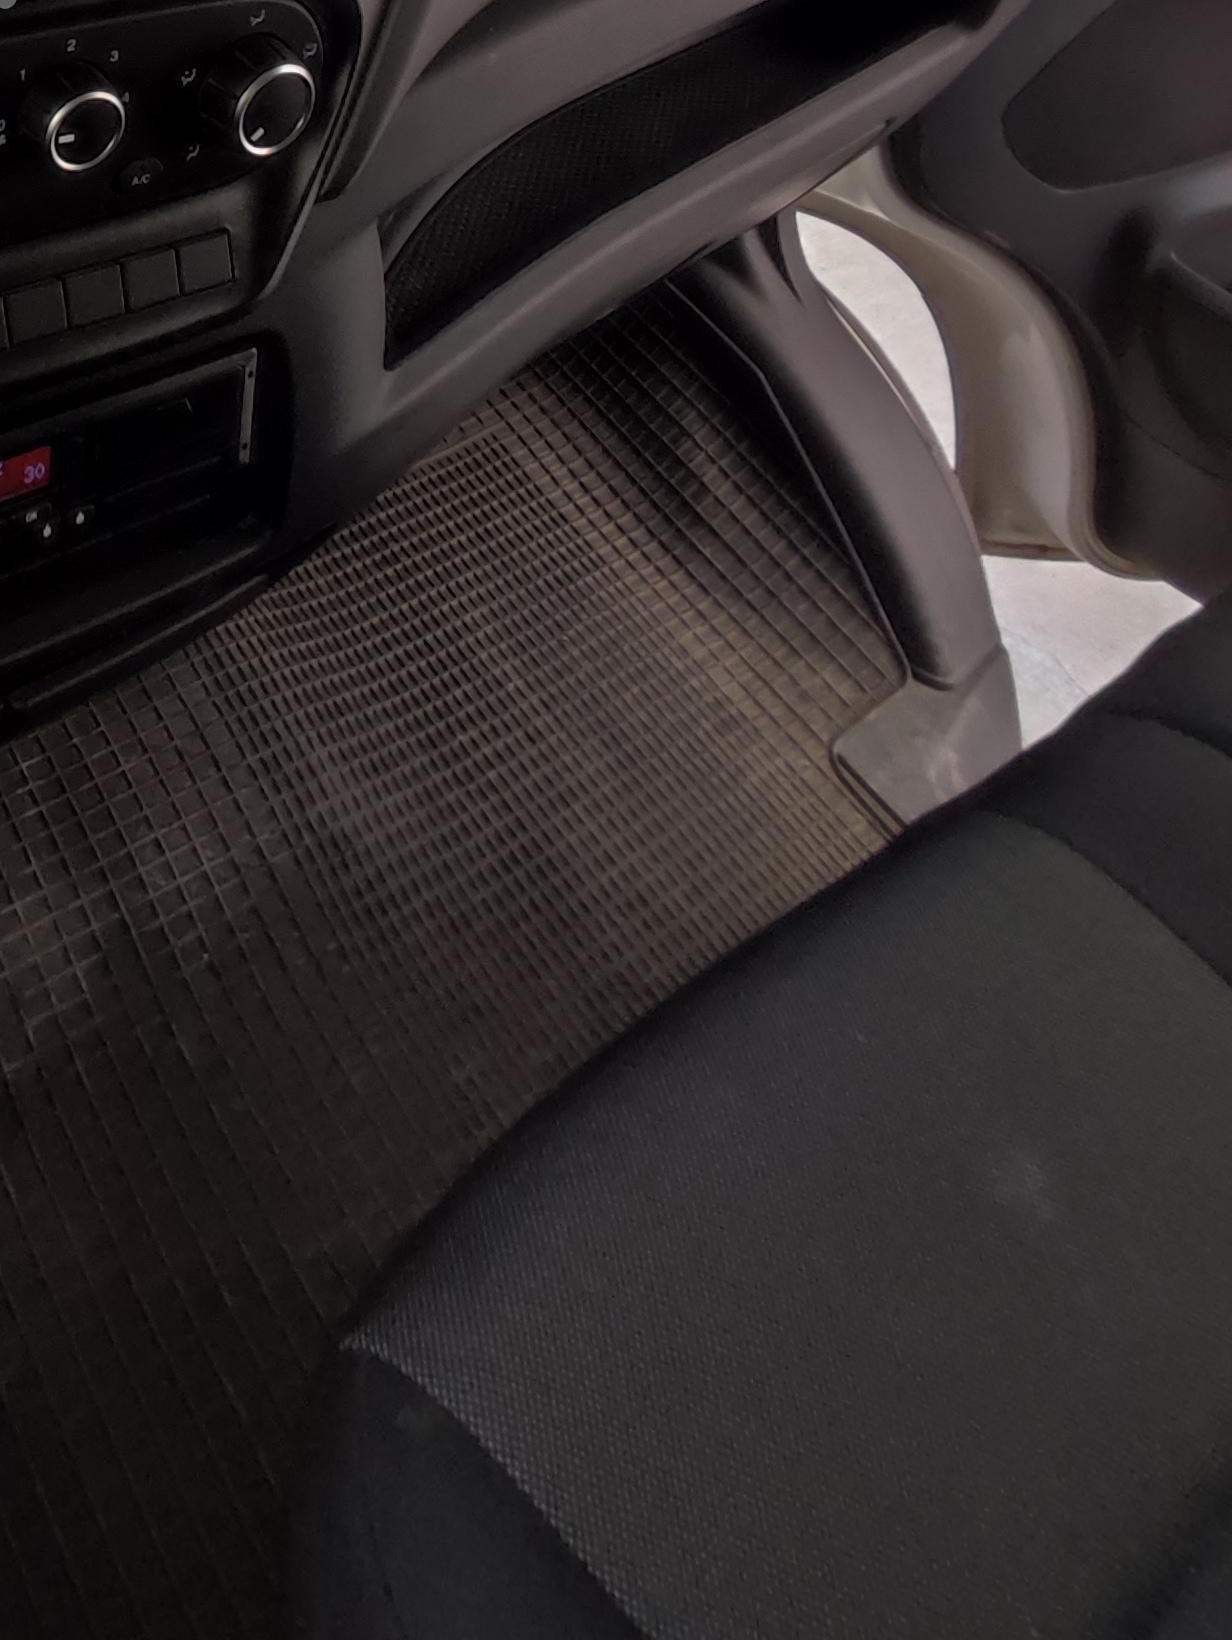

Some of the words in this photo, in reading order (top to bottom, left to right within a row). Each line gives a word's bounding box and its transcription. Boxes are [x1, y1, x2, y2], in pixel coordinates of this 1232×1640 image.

[66, 38, 77, 52] 2
[109, 49, 119, 62] 3
[19, 67, 26, 81] 1
[131, 173, 151, 186] A/C
